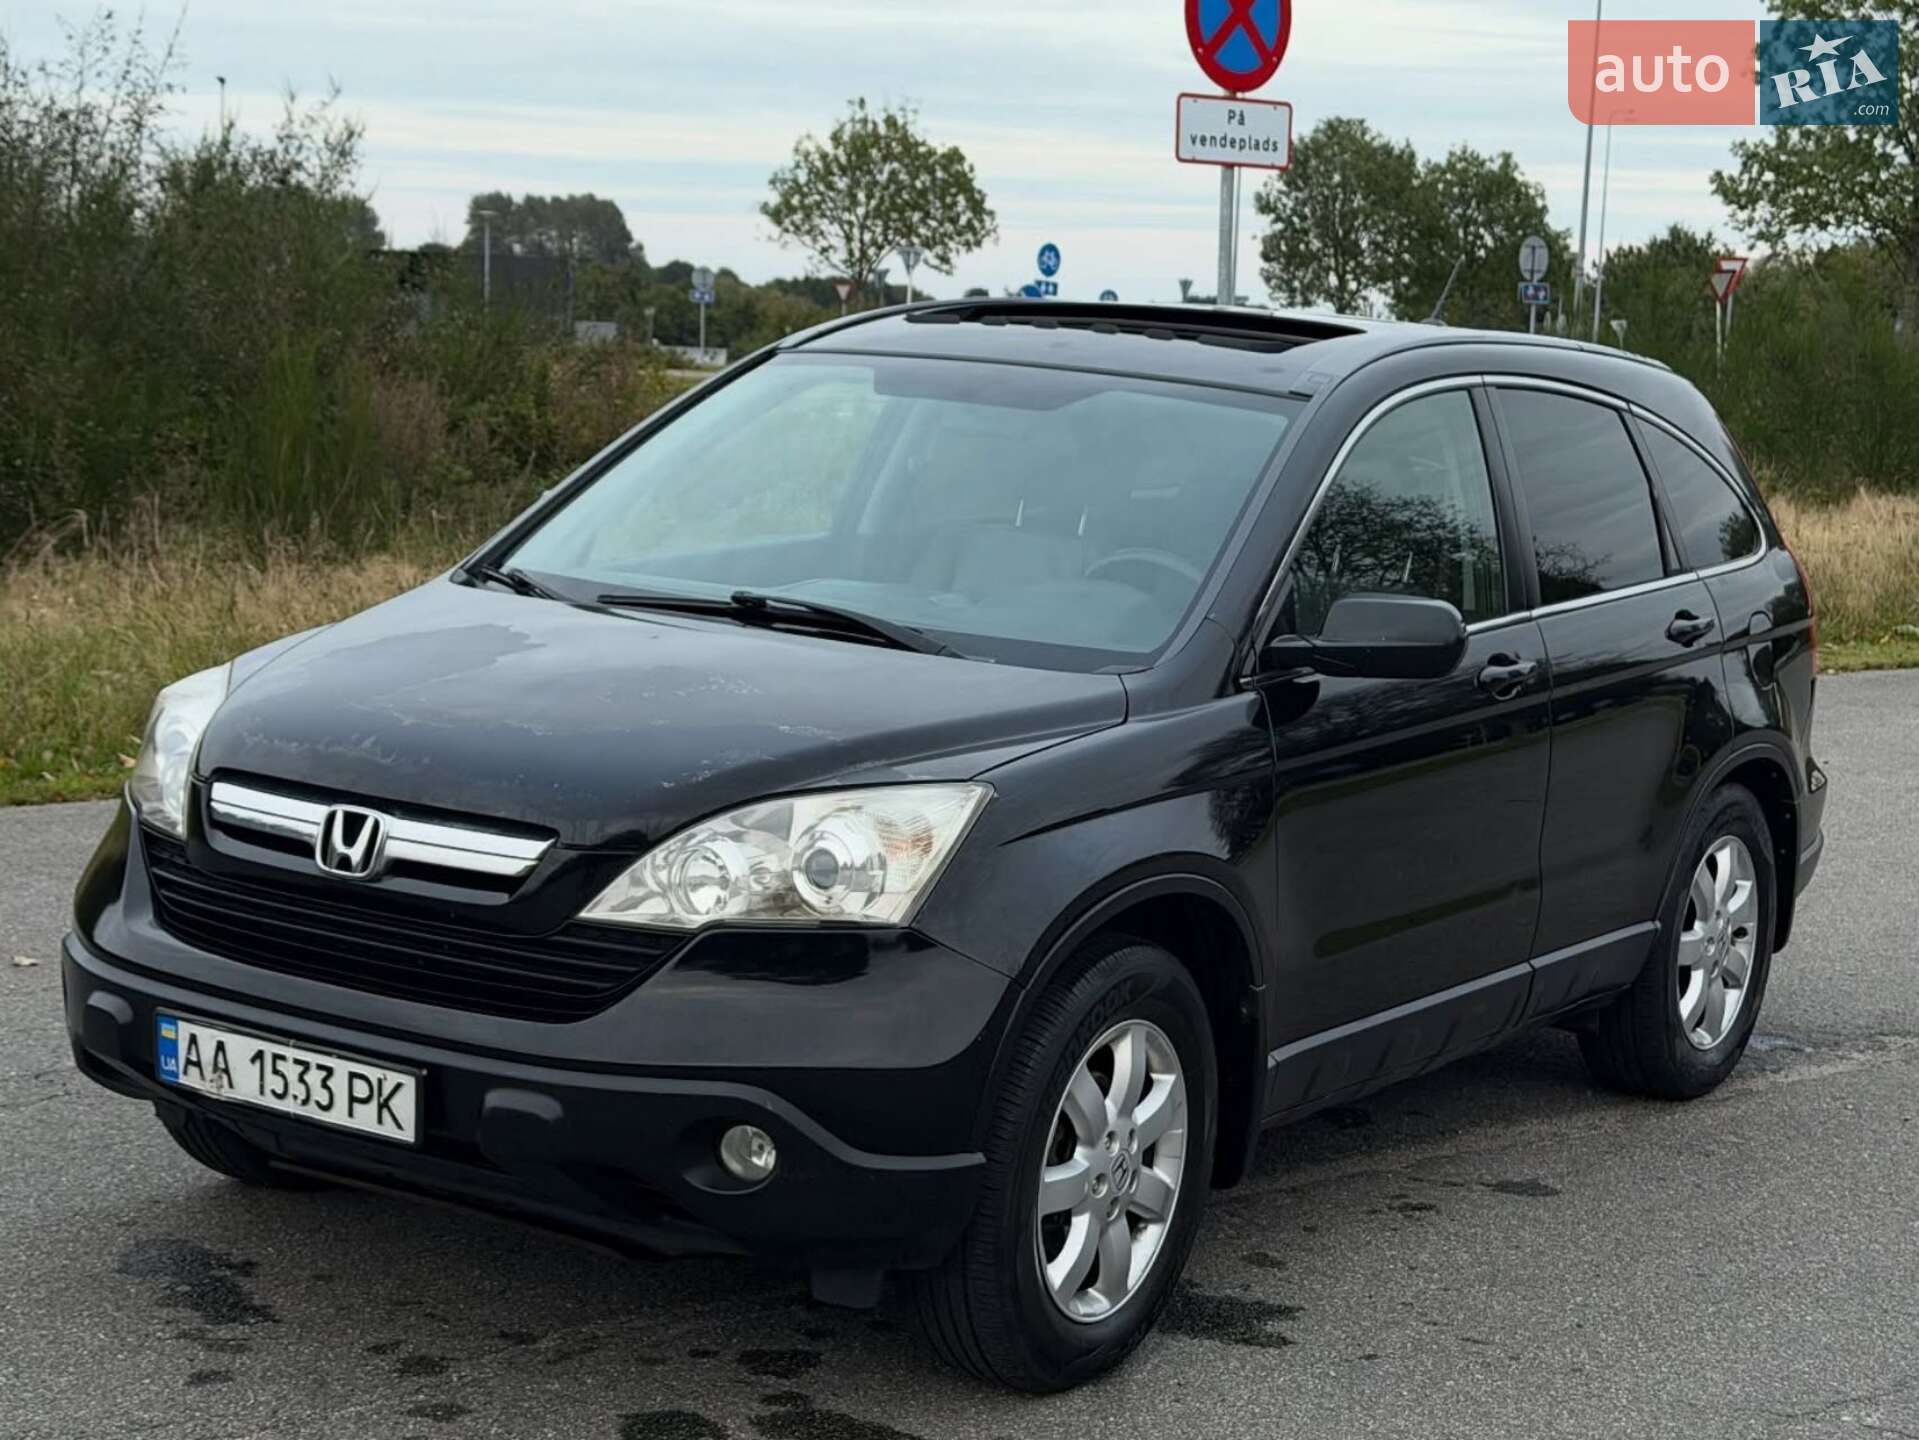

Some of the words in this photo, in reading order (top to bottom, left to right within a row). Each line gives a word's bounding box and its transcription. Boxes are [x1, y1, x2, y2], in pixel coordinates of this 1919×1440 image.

[1227, 108, 1246, 126] På
[1189, 132, 1279, 153] vendeplads
[160, 1055, 178, 1073] UA
[182, 1032, 235, 1090] AA
[249, 1048, 335, 1112] 1533
[347, 1070, 405, 1132] PK
